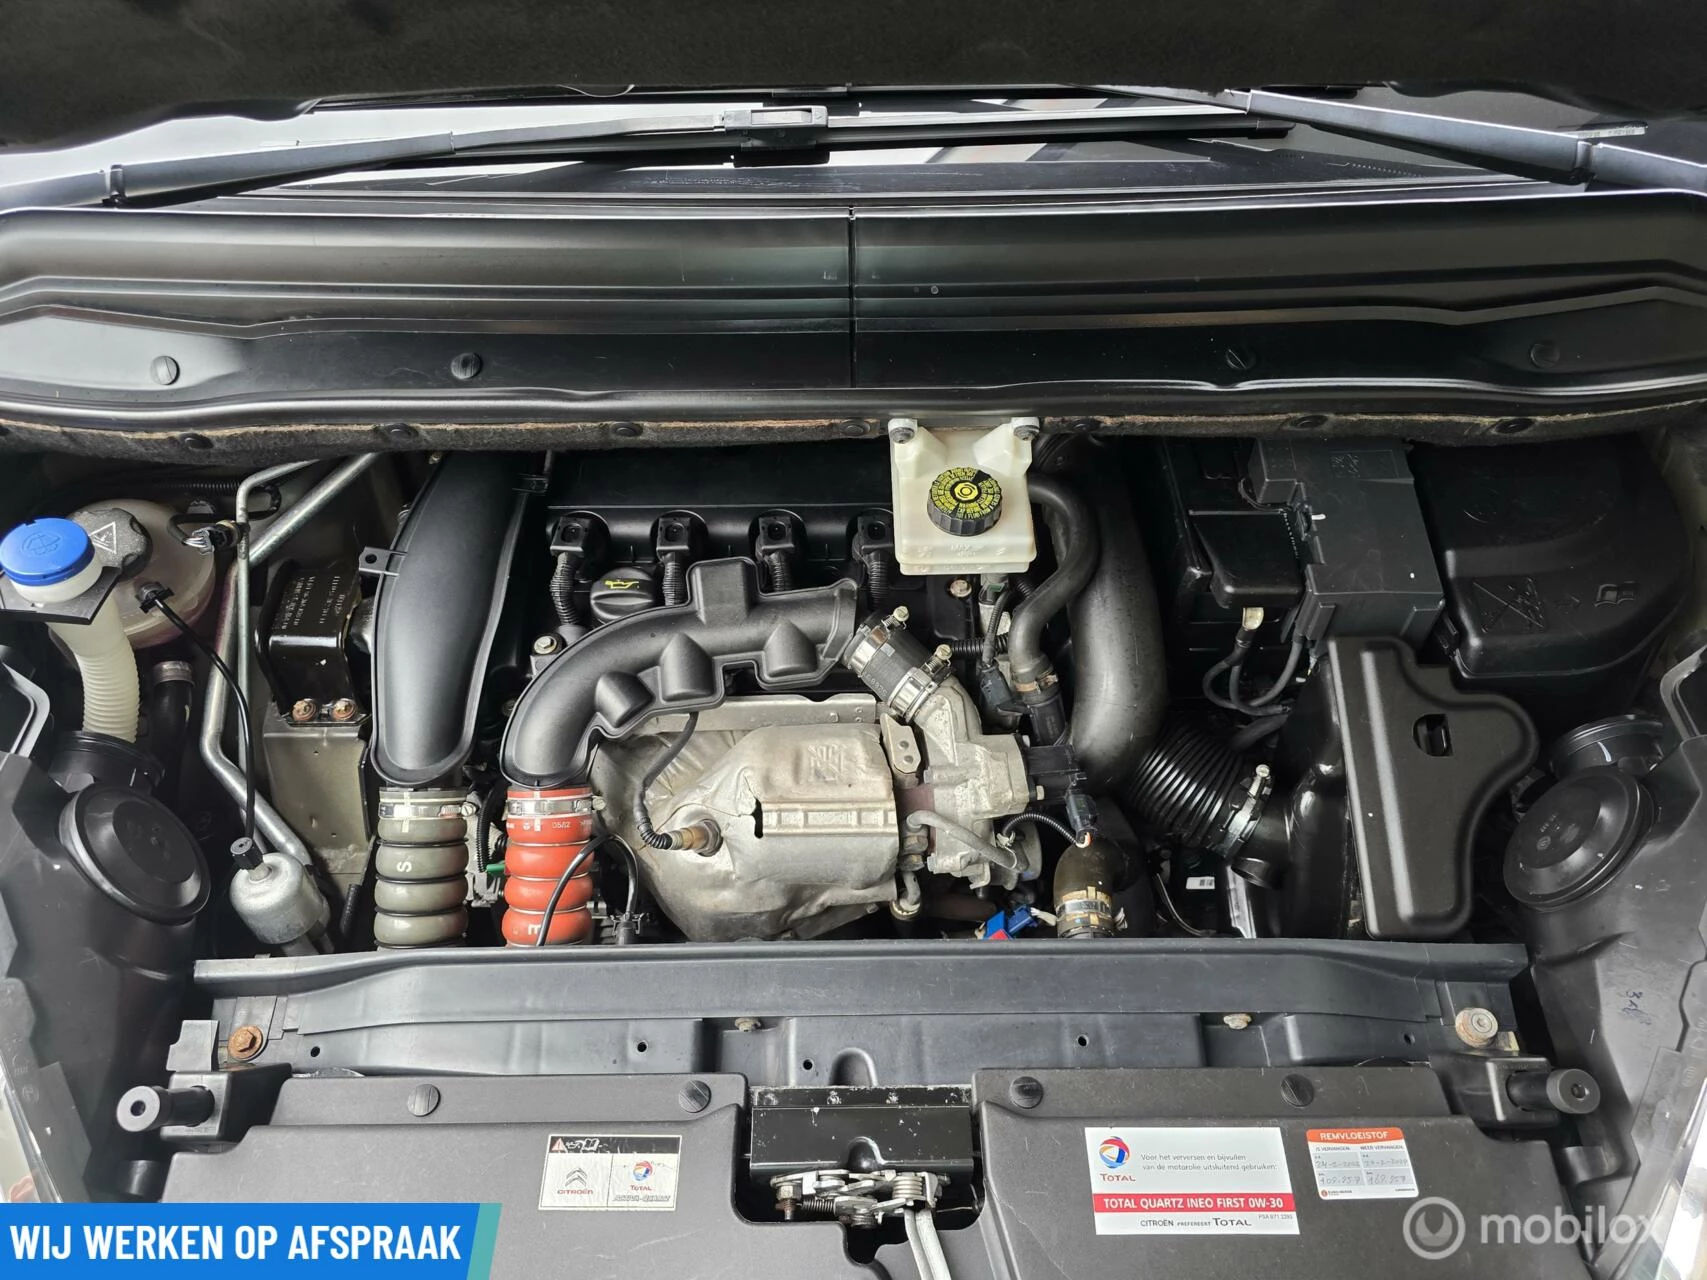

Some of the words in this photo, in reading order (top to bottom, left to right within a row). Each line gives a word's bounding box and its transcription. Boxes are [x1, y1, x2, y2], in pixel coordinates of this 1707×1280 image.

[1320, 1131, 1388, 1140] REMVLOEISTOF
[1104, 1198, 1137, 1208] TOTAL
[1140, 1198, 1184, 1209] QUARTZ
[1187, 1198, 1213, 1208] INEO
[1217, 1198, 1245, 1208] FIRST
[1249, 1198, 1283, 1208] 0W-30
